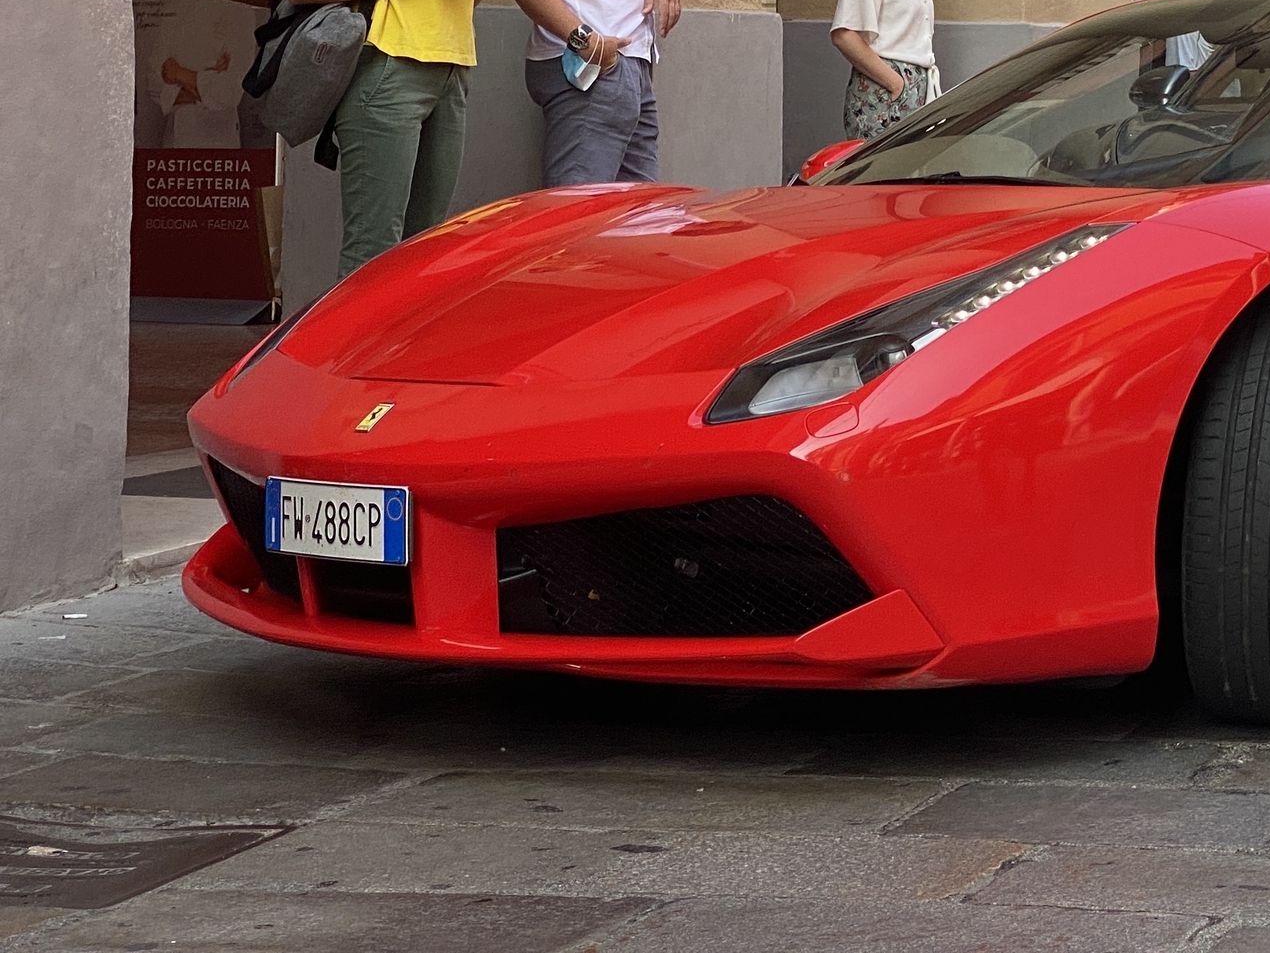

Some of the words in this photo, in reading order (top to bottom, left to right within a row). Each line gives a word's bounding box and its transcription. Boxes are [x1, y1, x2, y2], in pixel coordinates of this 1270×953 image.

[147, 159, 251, 172] PASTICCERIA
[146, 178, 251, 190] CAFFETTERIA
[146, 196, 250, 208] CIOCCOLATERIA
[145, 219, 198, 229] BOLOGNA
[207, 219, 249, 230] FAENZA
